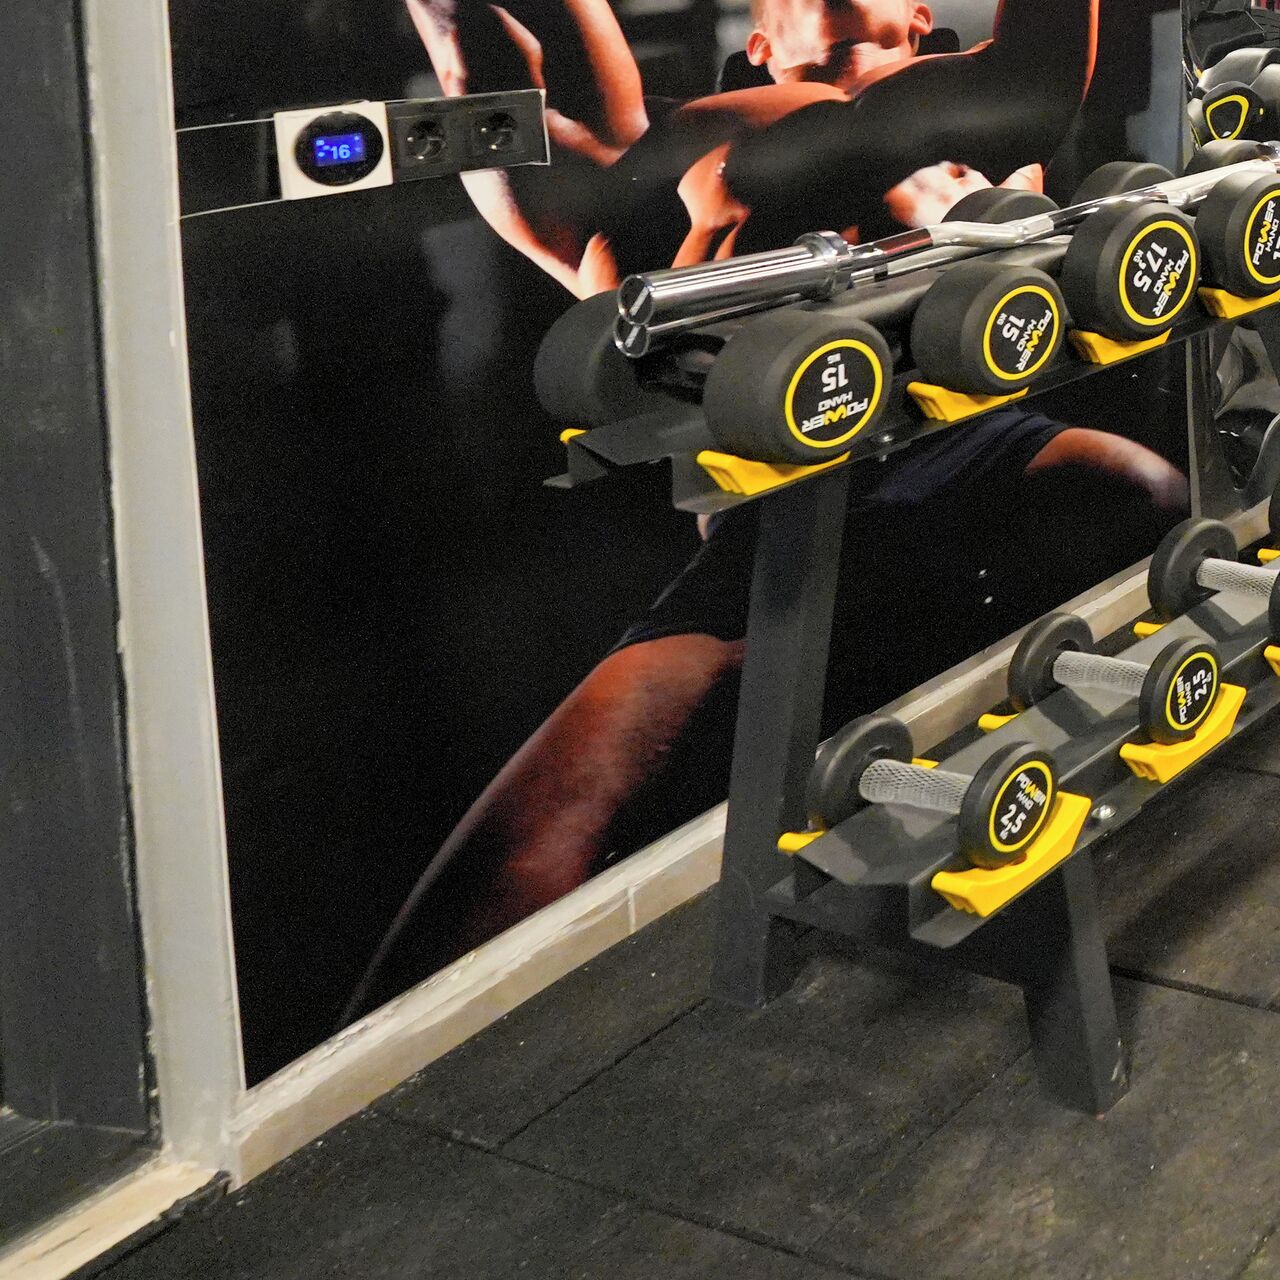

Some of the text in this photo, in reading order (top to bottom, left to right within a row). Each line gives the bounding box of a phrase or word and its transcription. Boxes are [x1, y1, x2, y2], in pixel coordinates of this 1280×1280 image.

[1252, 200, 1276, 266] POWER
[1265, 219, 1280, 252] HAND
[1152, 250, 1190, 317] POWER
[1153, 259, 1175, 295] HAND
[1002, 315, 1025, 342] 15
[1016, 319, 1037, 352] HAND
[1016, 309, 1053, 371] POWER
[821, 363, 849, 393] 15
[802, 398, 868, 433] POWER
[818, 391, 852, 412] HAND
[1177, 676, 1188, 724] POWER
[1016, 772, 1046, 807] POWER
